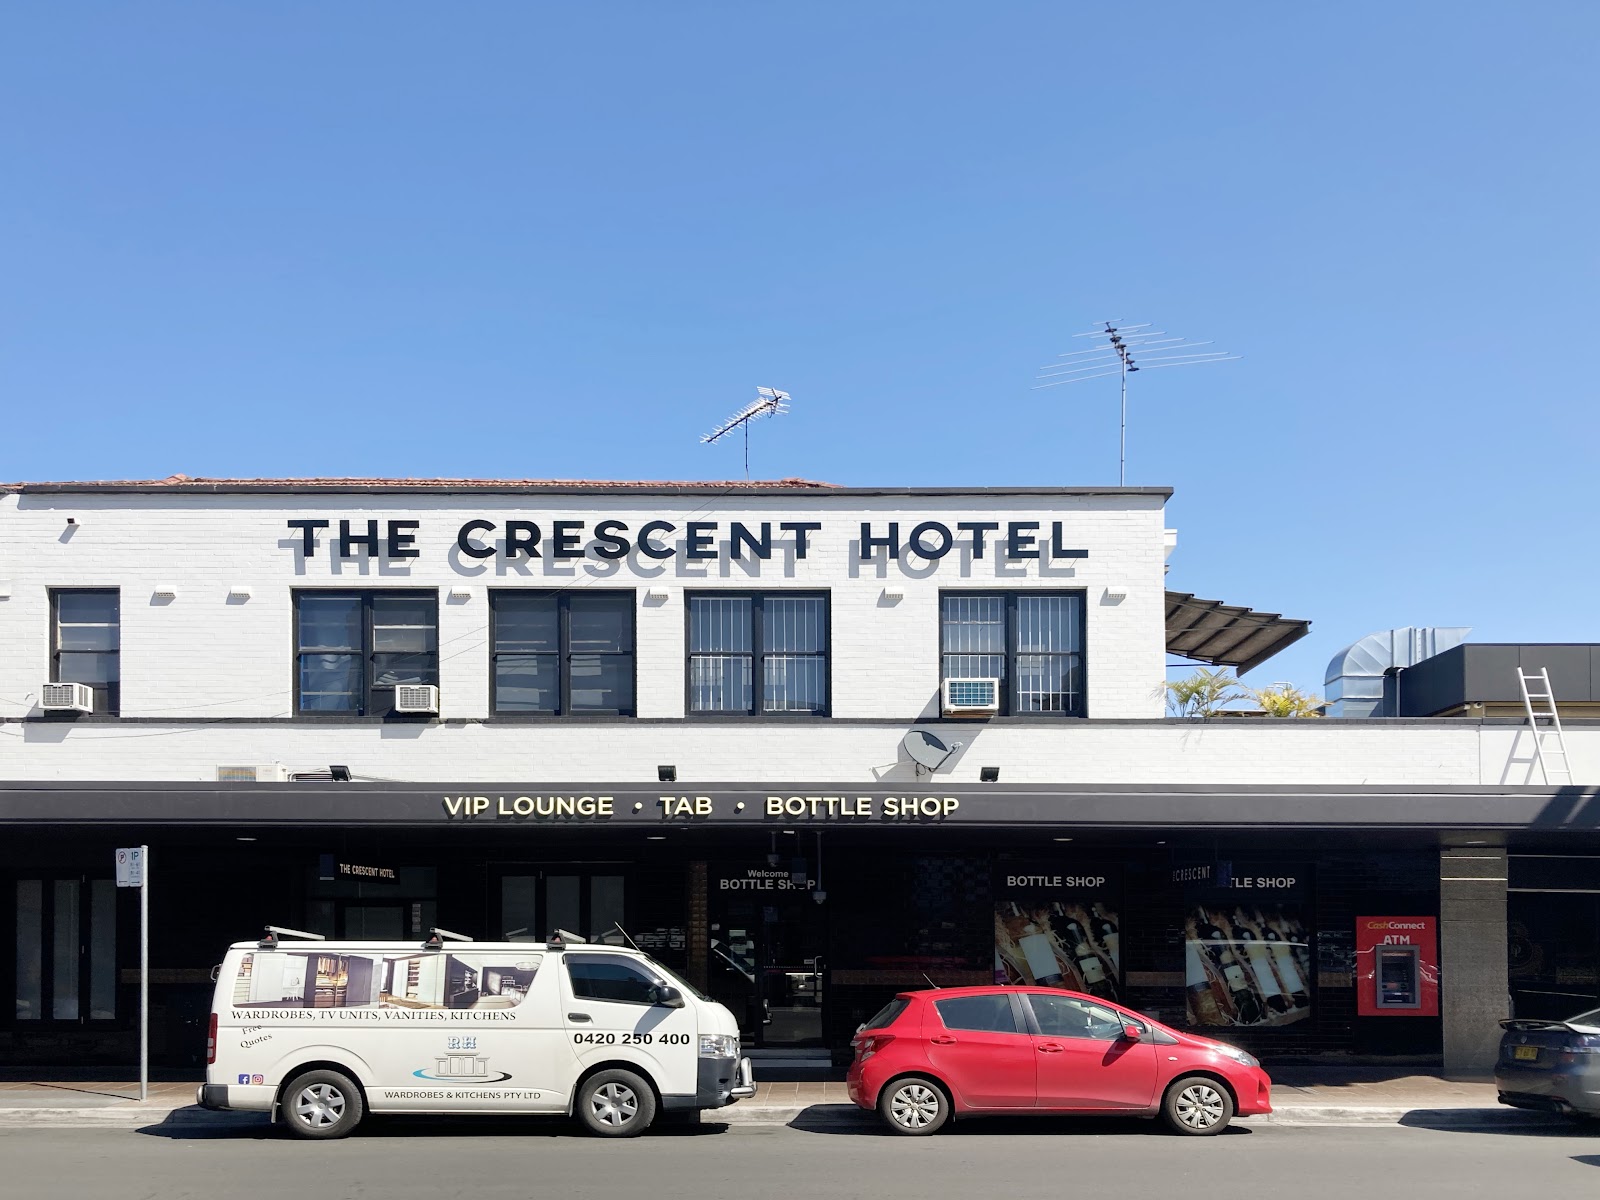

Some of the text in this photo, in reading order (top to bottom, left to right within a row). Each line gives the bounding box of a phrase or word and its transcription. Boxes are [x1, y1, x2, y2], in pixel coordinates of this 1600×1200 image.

[288, 519, 1088, 560] THE CRESCENT HOTEL
[444, 796, 960, 816] VIP LOUNGE TAB BOTTLE SHOP
[339, 863, 395, 879] THE CRESCENT HOTEL
[747, 870, 789, 878] Welcome
[1175, 866, 1210, 882] CRESCENT
[720, 879, 816, 890] BOTTLE SHP
[1007, 876, 1106, 888] BOTTLE SHOP
[1256, 877, 1296, 889] SHOP
[1367, 921, 1426, 930] CashConnect
[1383, 934, 1411, 945] ATM
[231, 1010, 516, 1022] WARDROBES, TV UNITS, VANITIES, KITCHENS
[242, 1025, 262, 1035] Free
[240, 1034, 273, 1049] Quotes
[573, 1032, 690, 1046] 0420 250 400
[384, 1091, 542, 1100] WARDROBES & KITCHENS PTY LTD
